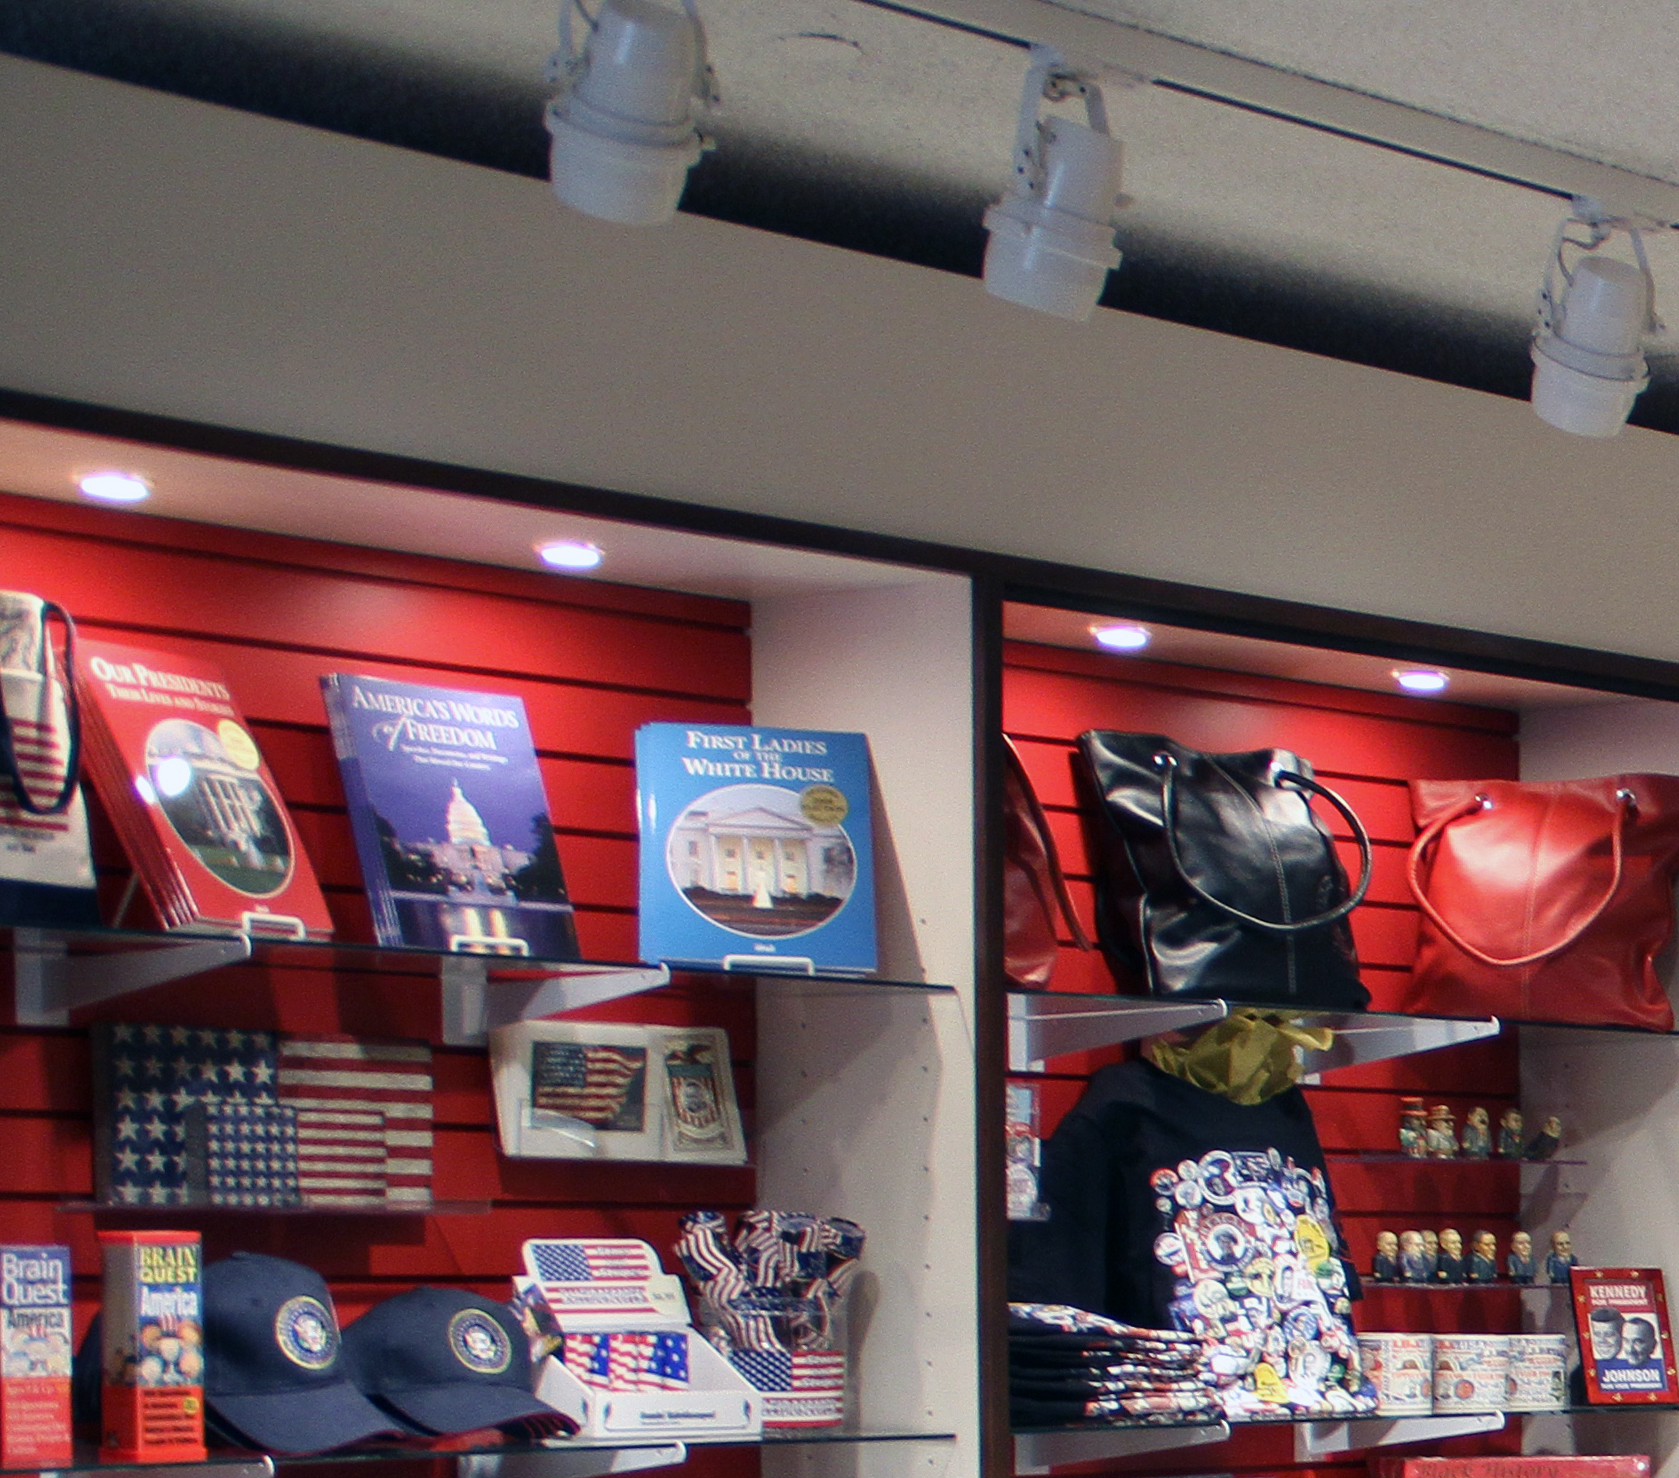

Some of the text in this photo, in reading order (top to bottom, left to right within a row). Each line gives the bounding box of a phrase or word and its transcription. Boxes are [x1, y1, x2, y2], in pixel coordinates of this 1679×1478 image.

[352, 685, 519, 729] AMERICA'S WORDS
[404, 720, 498, 750] FREEDOM
[686, 730, 828, 755] FIRST LADIES
[682, 757, 835, 783] WHITE HOUSE
[2, 1252, 63, 1283] Brain
[140, 1246, 198, 1267] BRAIN
[140, 1266, 198, 1285] QUEST
[2, 1280, 69, 1306] Quest
[1588, 1285, 1647, 1298] KENNEDY
[1602, 1368, 1660, 1382] JOHNSON
